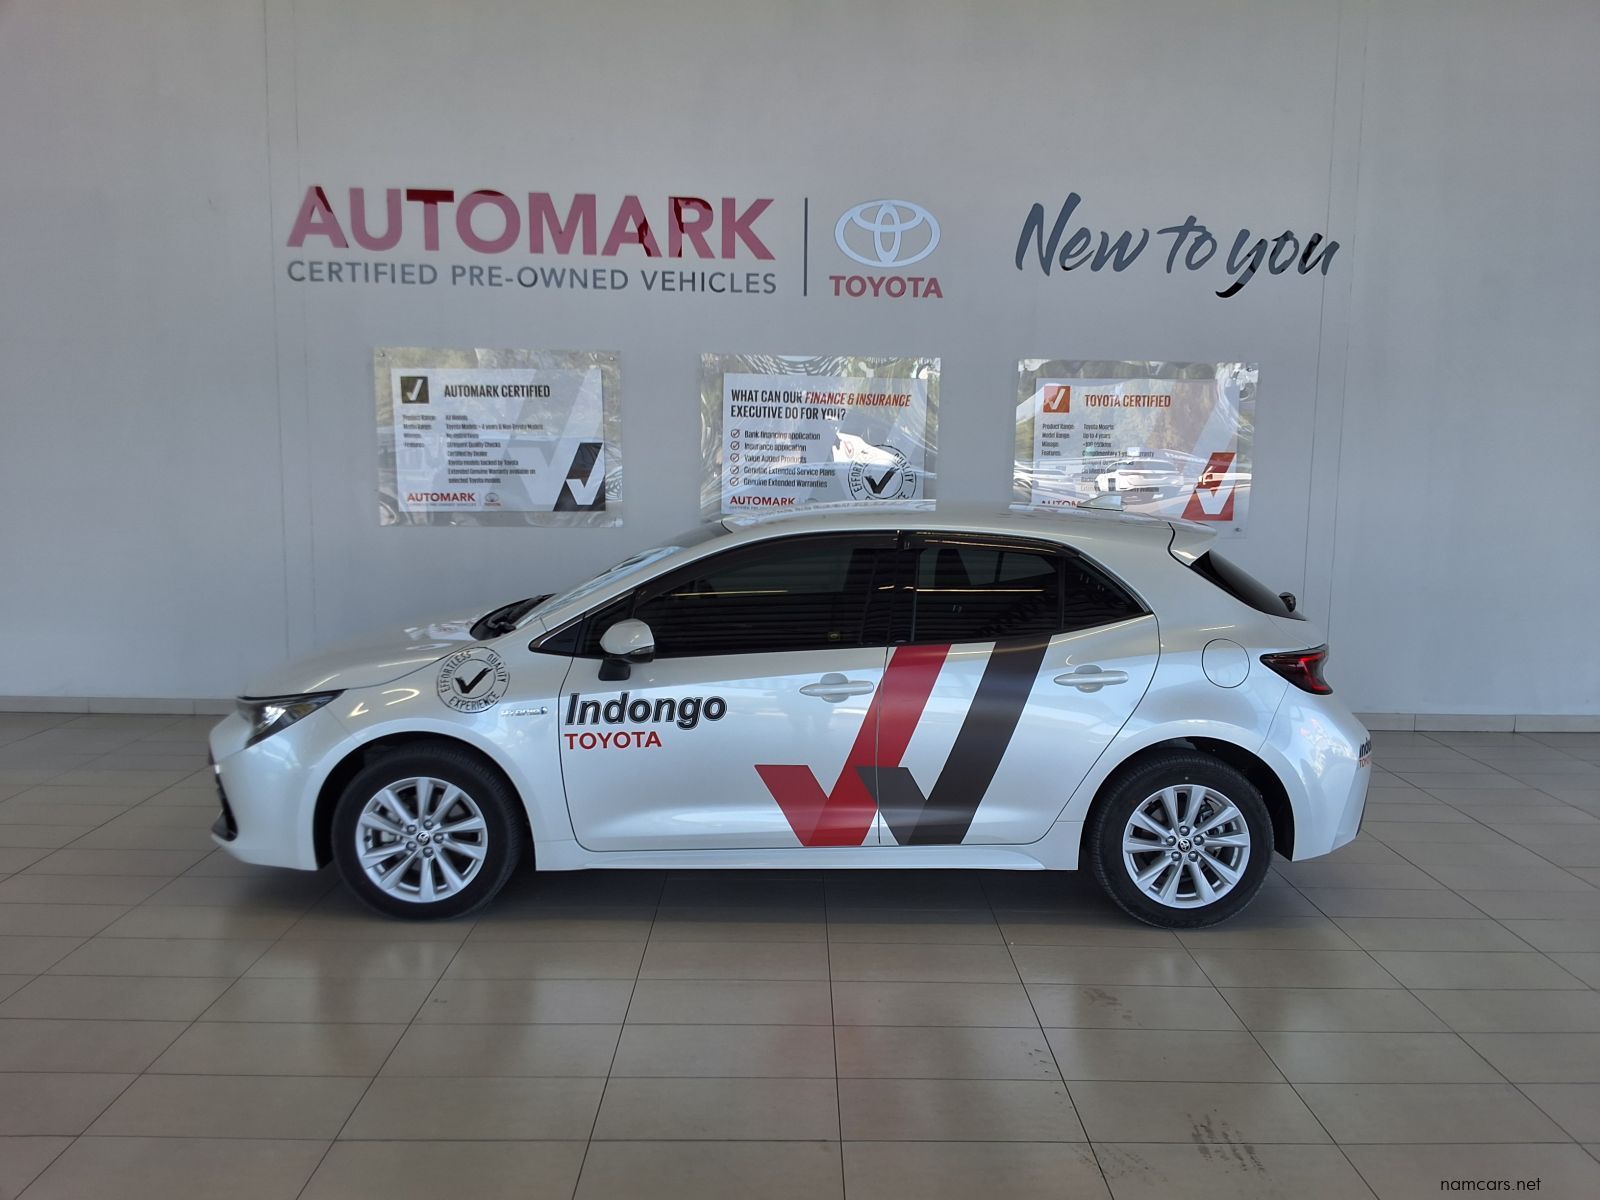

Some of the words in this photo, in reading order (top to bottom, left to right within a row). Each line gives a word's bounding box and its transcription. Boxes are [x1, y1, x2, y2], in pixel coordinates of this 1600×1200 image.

[286, 185, 777, 261] AUTOMARK
[1015, 192, 1149, 277] New
[1156, 215, 1218, 274] to
[1215, 228, 1340, 298] you
[287, 261, 437, 286] CERTIFIED
[451, 265, 629, 291] PRE-OWNED
[641, 270, 777, 294] VEHICLES
[829, 275, 943, 299] TOYOTA
[444, 384, 499, 398] AUTOMARK
[501, 385, 550, 398] CERTIFIED
[731, 388, 759, 402] WHAT
[761, 390, 780, 403] CAN
[782, 391, 802, 404] OUR
[804, 392, 845, 405] FINANCE
[856, 393, 912, 407] INSURANCE
[1084, 394, 1121, 408] TOYOTA
[1122, 394, 1171, 408] CERTIFIED
[730, 405, 783, 419] EXECUTIVE
[784, 407, 798, 419] DO
[800, 407, 819, 420] FOR
[821, 408, 846, 421] YOU?
[744, 430, 759, 439] Bank
[760, 431, 788, 441] financing
[789, 432, 821, 441] application
[744, 442, 773, 450] Insurance
[774, 443, 807, 452] application
[744, 454, 760, 462] Value
[761, 455, 780, 463] Added
[768, 466, 796, 475] Extended
[796, 467, 819, 476] Service
[819, 468, 836, 476] Plans
[743, 478, 767, 486] Genuine
[768, 479, 796, 487] Extended
[796, 479, 828, 488] Warranties
[407, 492, 476, 502] AUTOMARK
[730, 495, 796, 506] AUTOMARK
[440, 650, 472, 693] EFFORTLESS
[486, 653, 507, 683] QUALITY
[448, 691, 500, 711] EXPERIENCE
[565, 691, 727, 730] Indongo
[564, 731, 662, 750] TOYOTA
